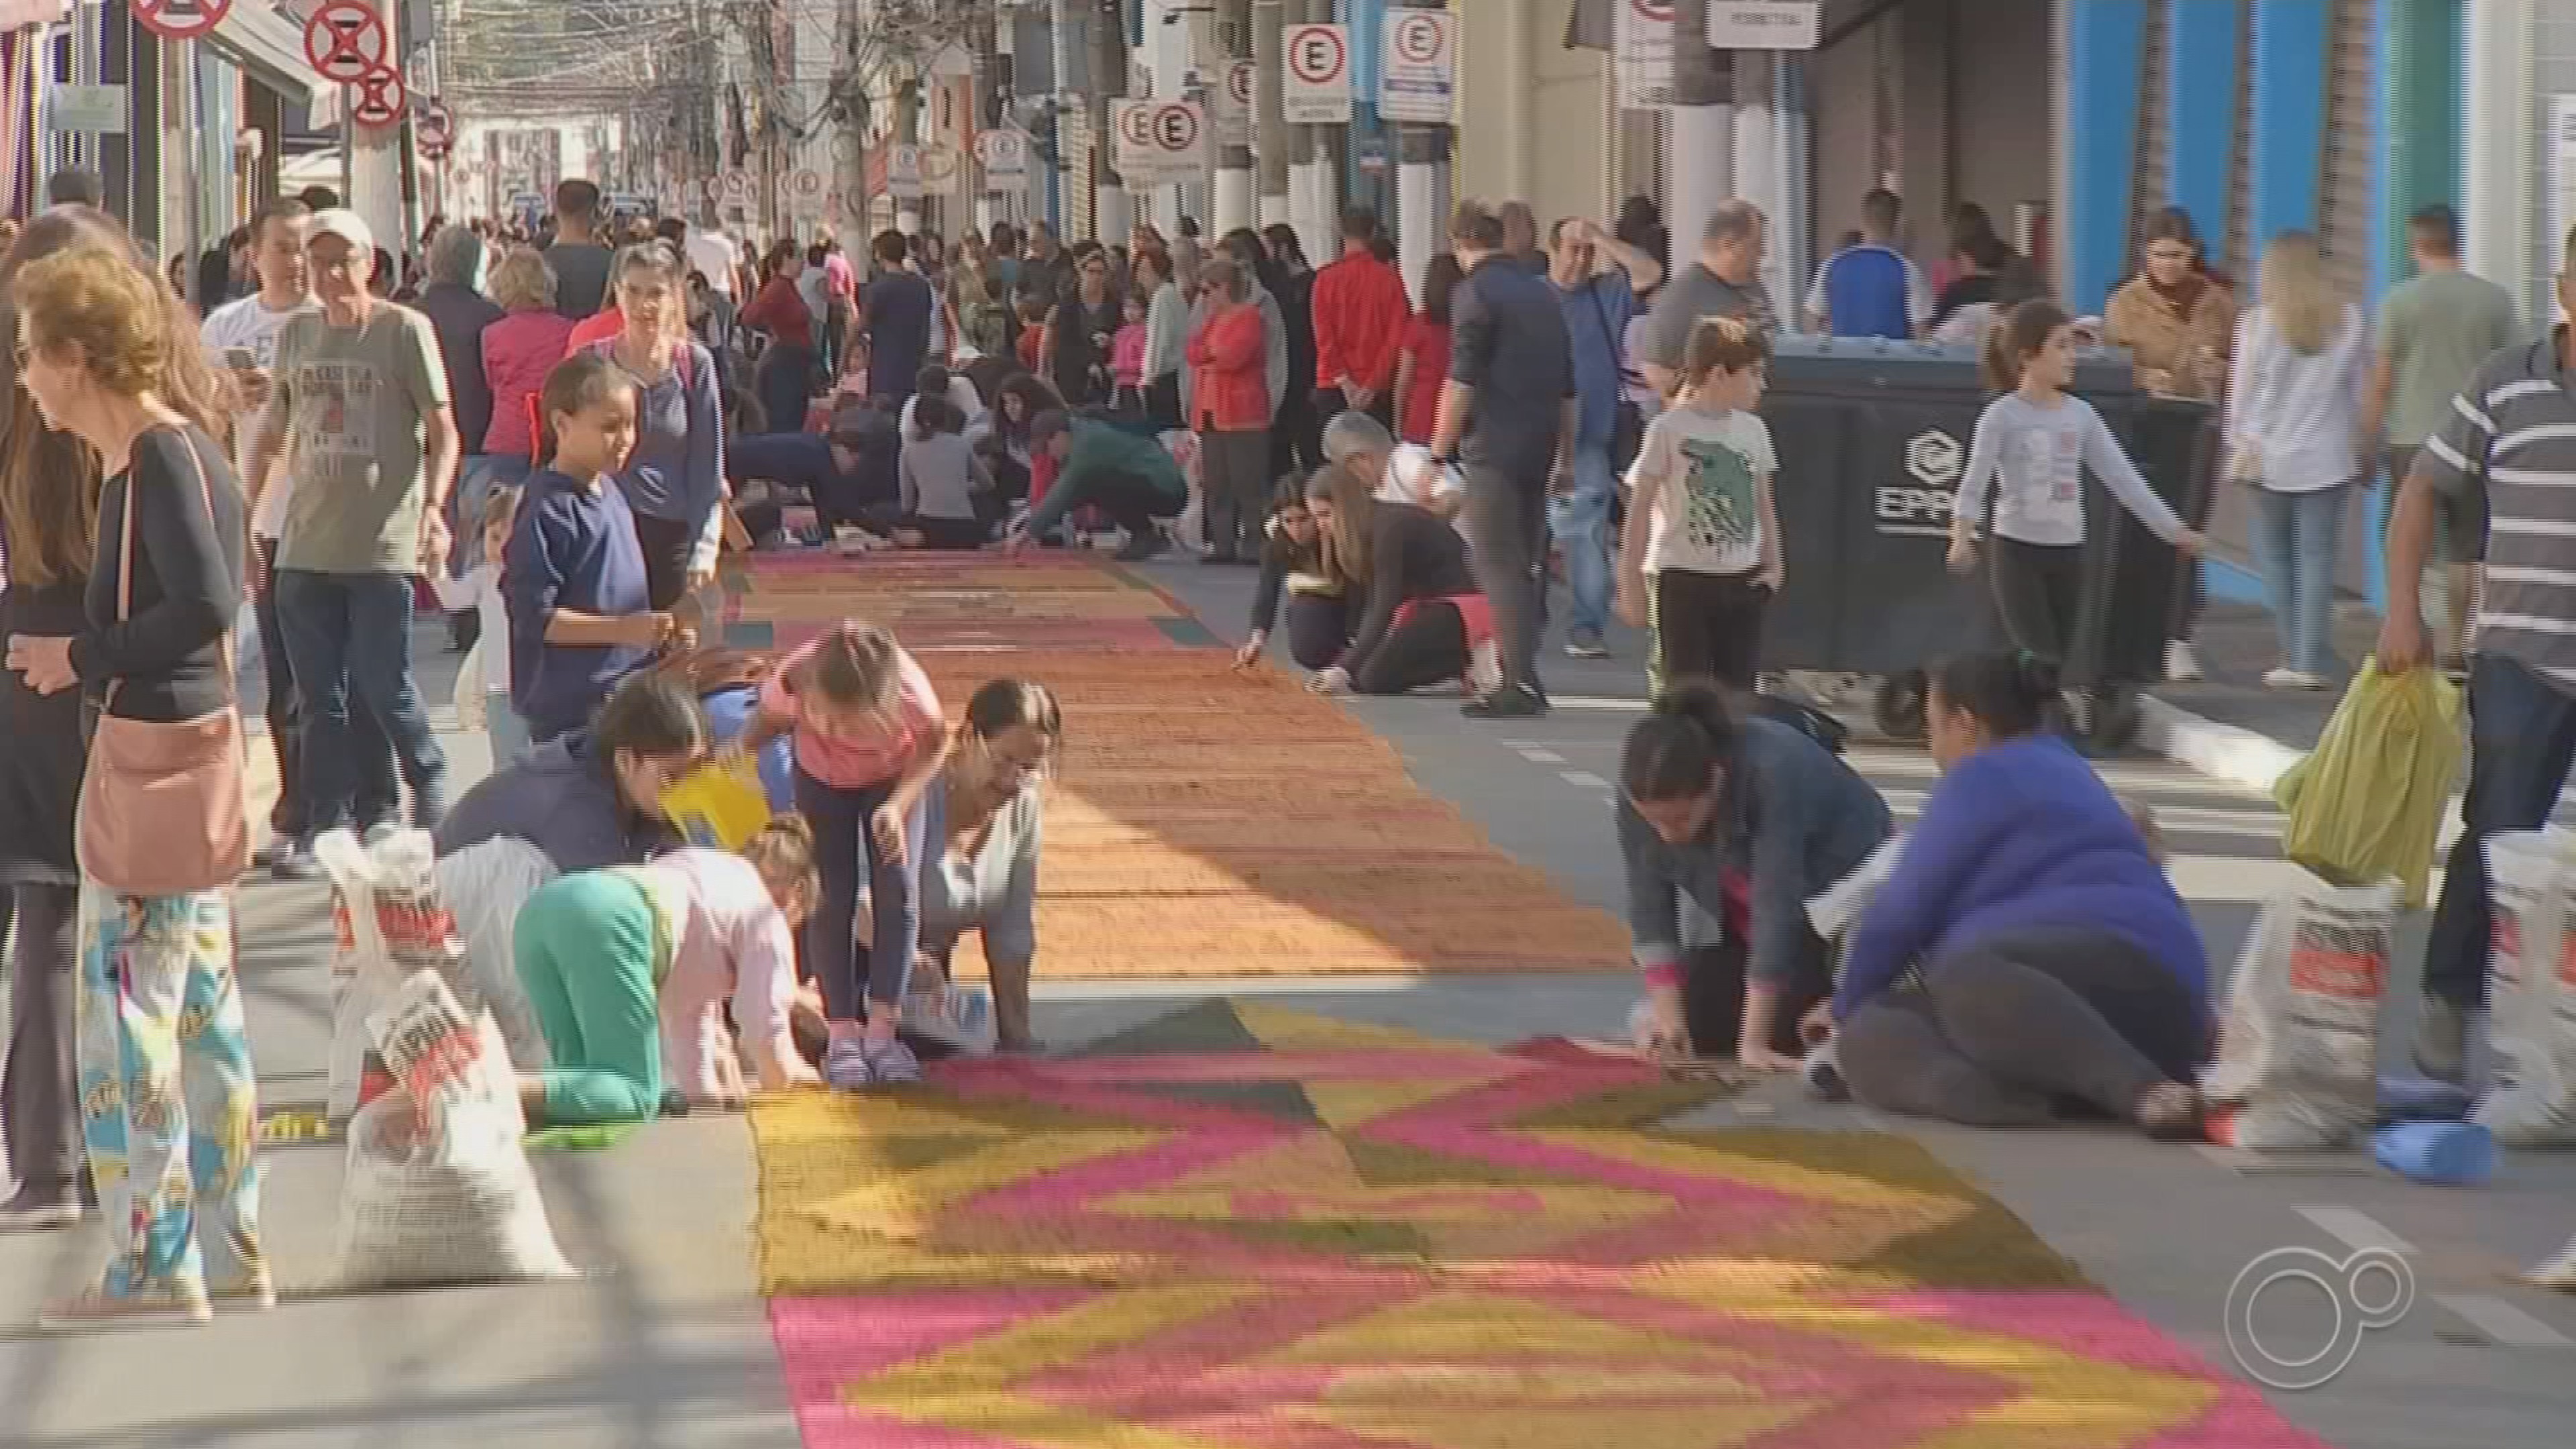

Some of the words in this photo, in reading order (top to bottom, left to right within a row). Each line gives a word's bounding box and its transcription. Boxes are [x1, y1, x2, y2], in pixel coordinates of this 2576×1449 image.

[1409, 25, 1434, 52] E
[1305, 40, 1329, 70] E
[1134, 111, 1150, 138] E
[1165, 113, 1185, 143] E
[1875, 487, 1955, 520] EPP
